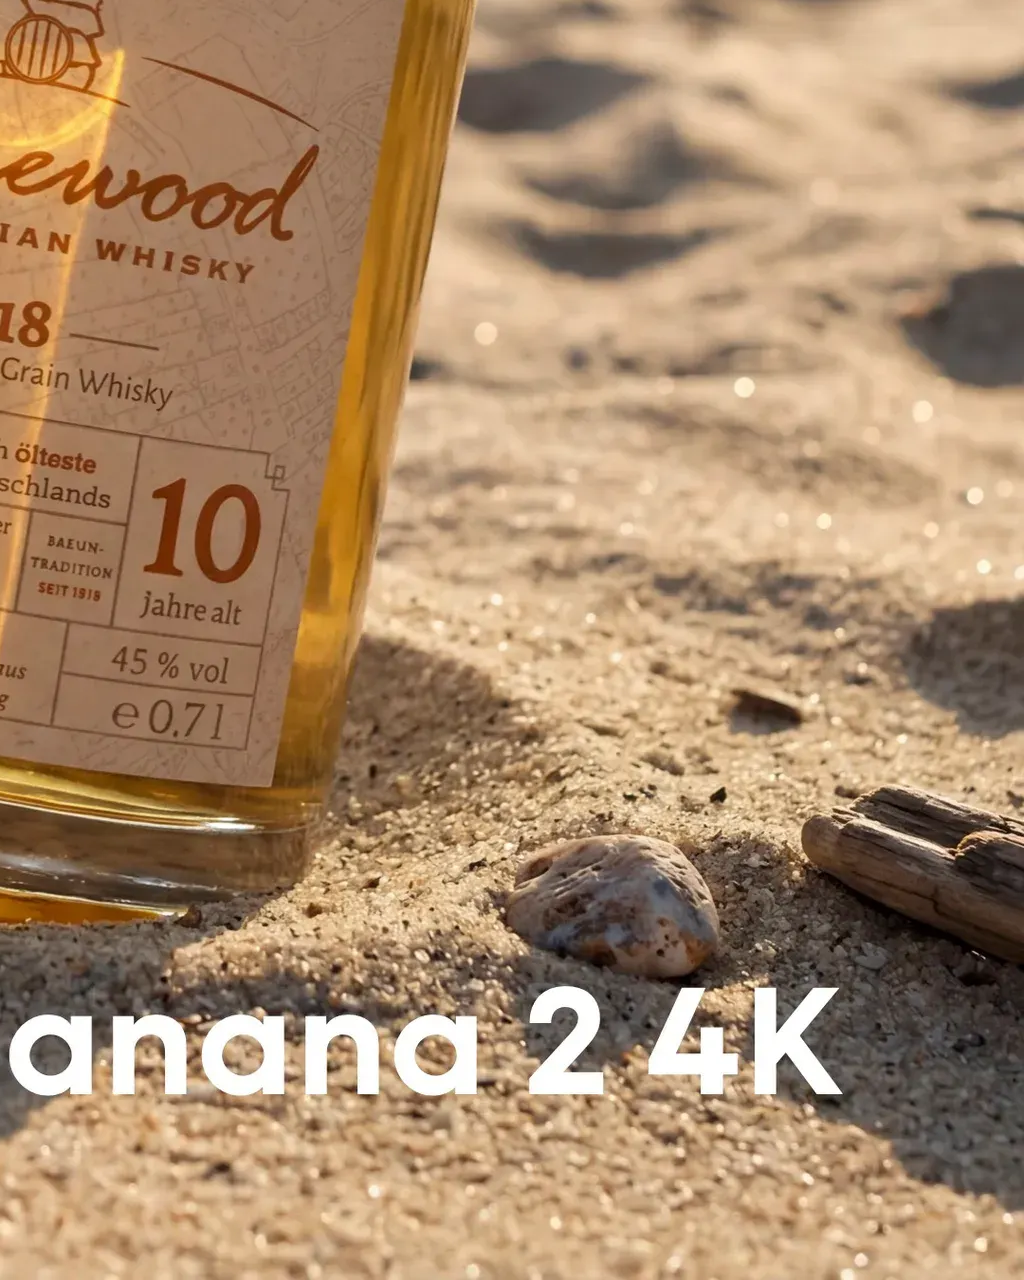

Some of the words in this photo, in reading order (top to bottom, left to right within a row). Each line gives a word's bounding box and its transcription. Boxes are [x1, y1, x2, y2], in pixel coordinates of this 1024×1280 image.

[95, 238, 256, 285] WHISKY
[0, 356, 70, 391] Grain
[78, 367, 174, 412] Whisky
[142, 477, 262, 584] 10
[30, 556, 113, 580] TRADITION
[37, 581, 70, 597] SEIT
[210, 599, 243, 626] alt
[111, 645, 148, 675] 45
[157, 651, 180, 679] %
[189, 656, 229, 685] vol
